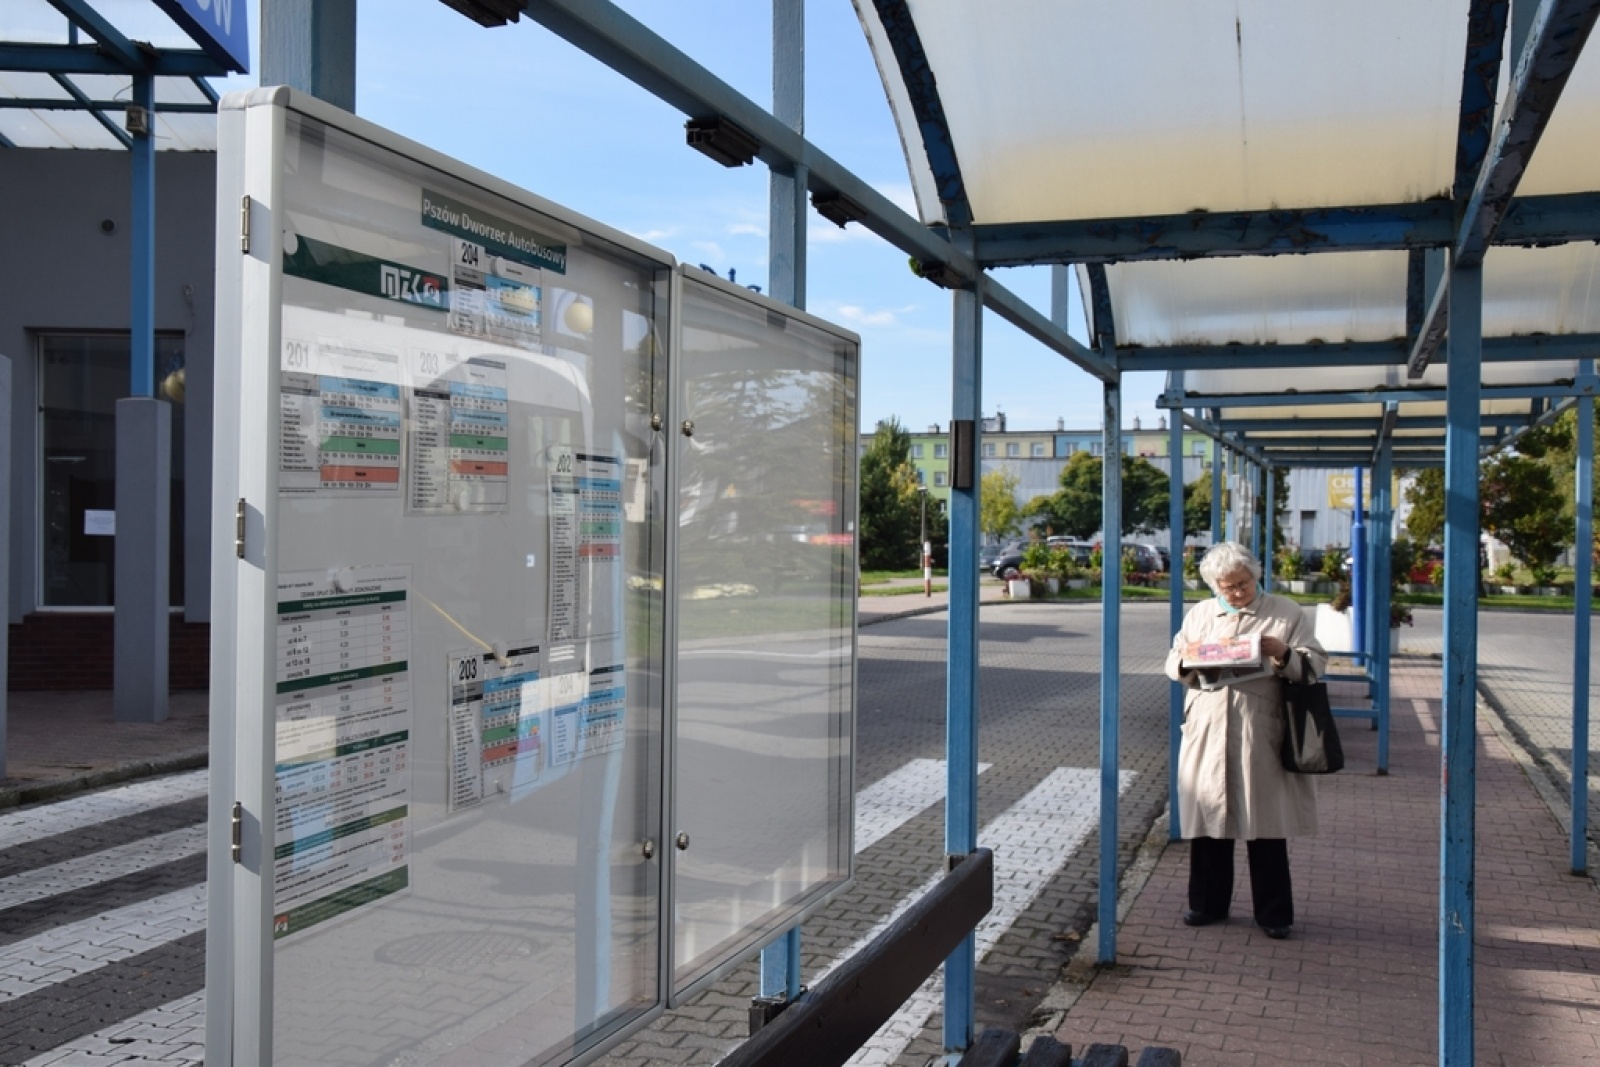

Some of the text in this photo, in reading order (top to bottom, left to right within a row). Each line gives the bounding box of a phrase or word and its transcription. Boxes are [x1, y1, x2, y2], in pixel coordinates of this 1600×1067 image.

[423, 199, 566, 270] Pszów Dworzec Autobusowy
[461, 241, 479, 267] 204
[285, 341, 309, 368] 201
[419, 351, 439, 375] 203
[459, 658, 477, 680] 203
